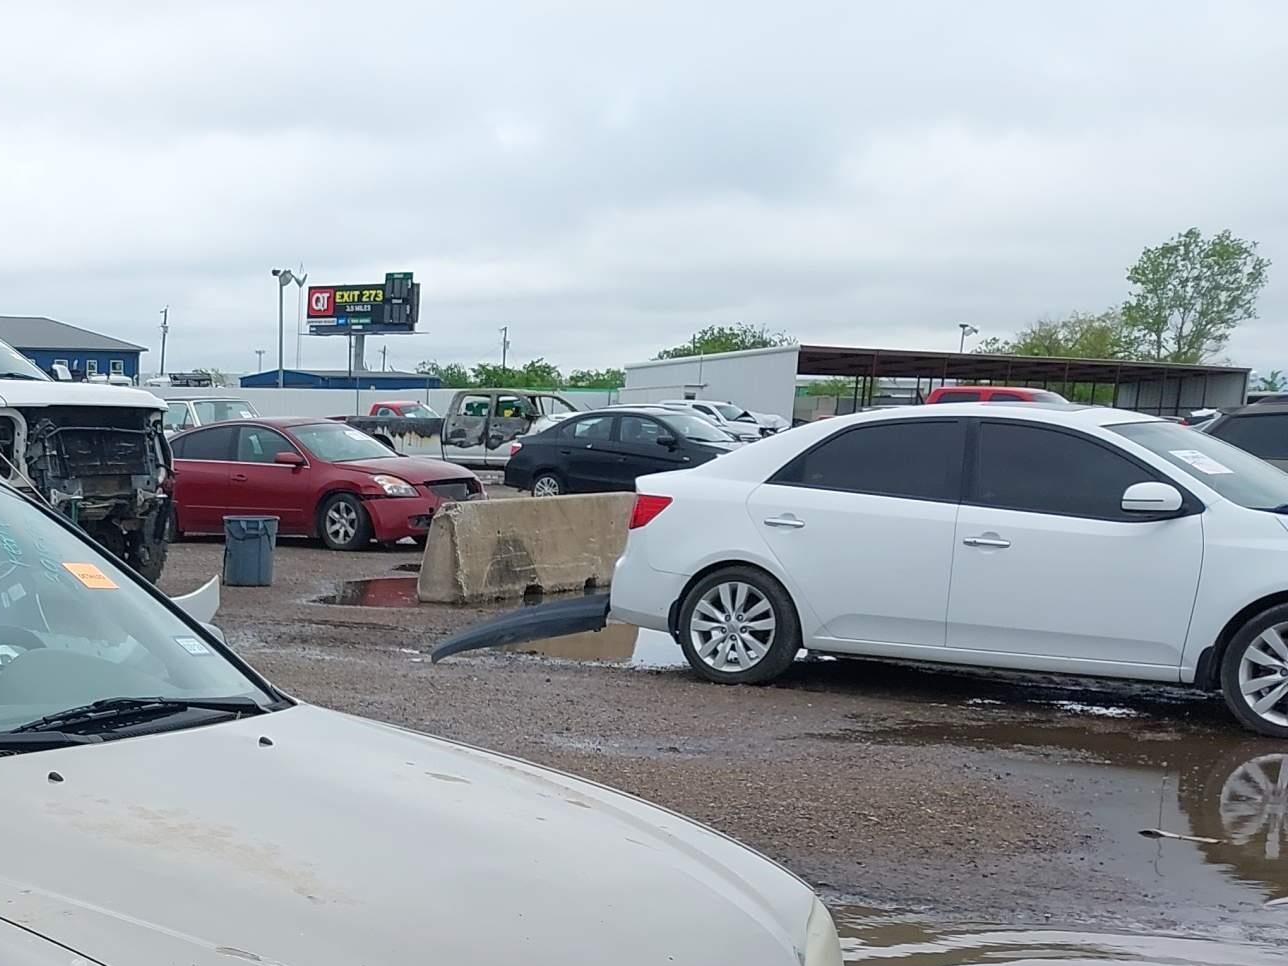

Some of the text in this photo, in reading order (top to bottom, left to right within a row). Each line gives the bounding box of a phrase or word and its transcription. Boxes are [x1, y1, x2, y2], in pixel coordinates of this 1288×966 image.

[312, 293, 329, 311] QT
[335, 290, 383, 302] EXIT 273
